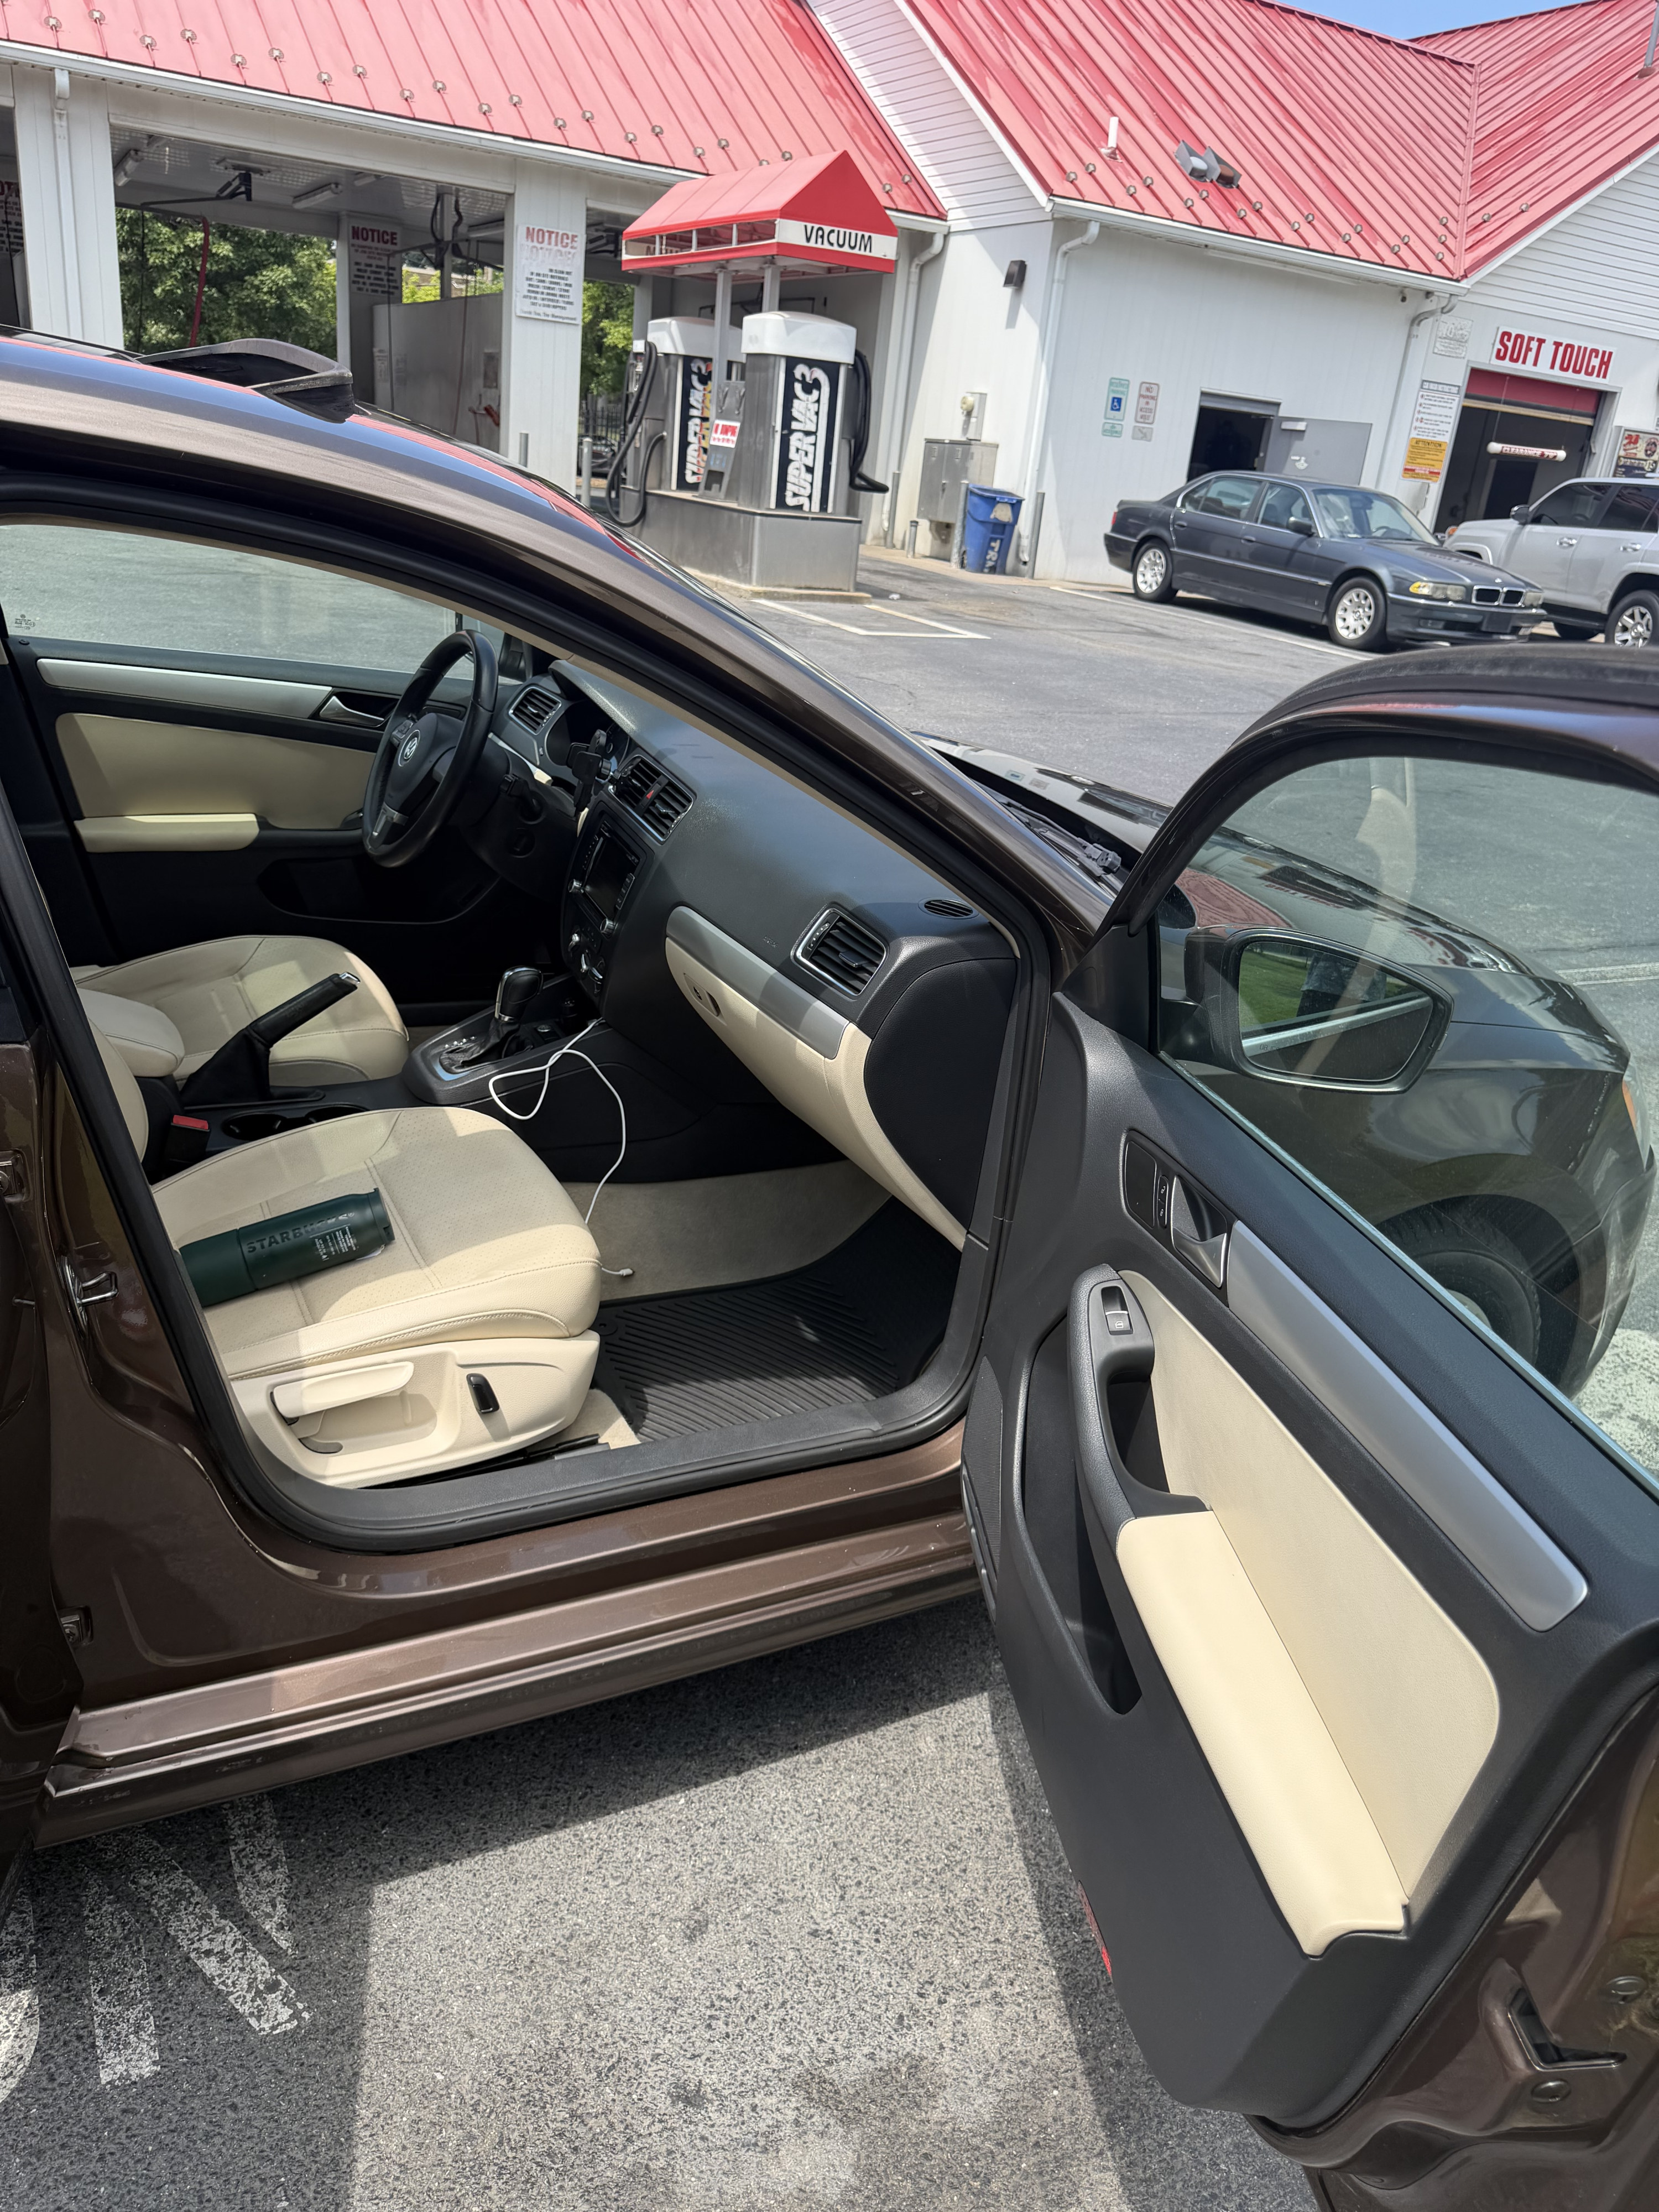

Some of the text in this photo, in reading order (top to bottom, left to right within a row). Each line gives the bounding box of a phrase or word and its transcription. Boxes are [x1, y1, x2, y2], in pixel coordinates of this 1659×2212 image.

[351, 225, 398, 246] NOTICE
[525, 226, 578, 250] NOTICE
[804, 224, 872, 253] VACUUM
[1495, 331, 1547, 367] SOFT
[1550, 340, 1613, 379] TOUCH
[785, 431, 817, 512] SUPER
